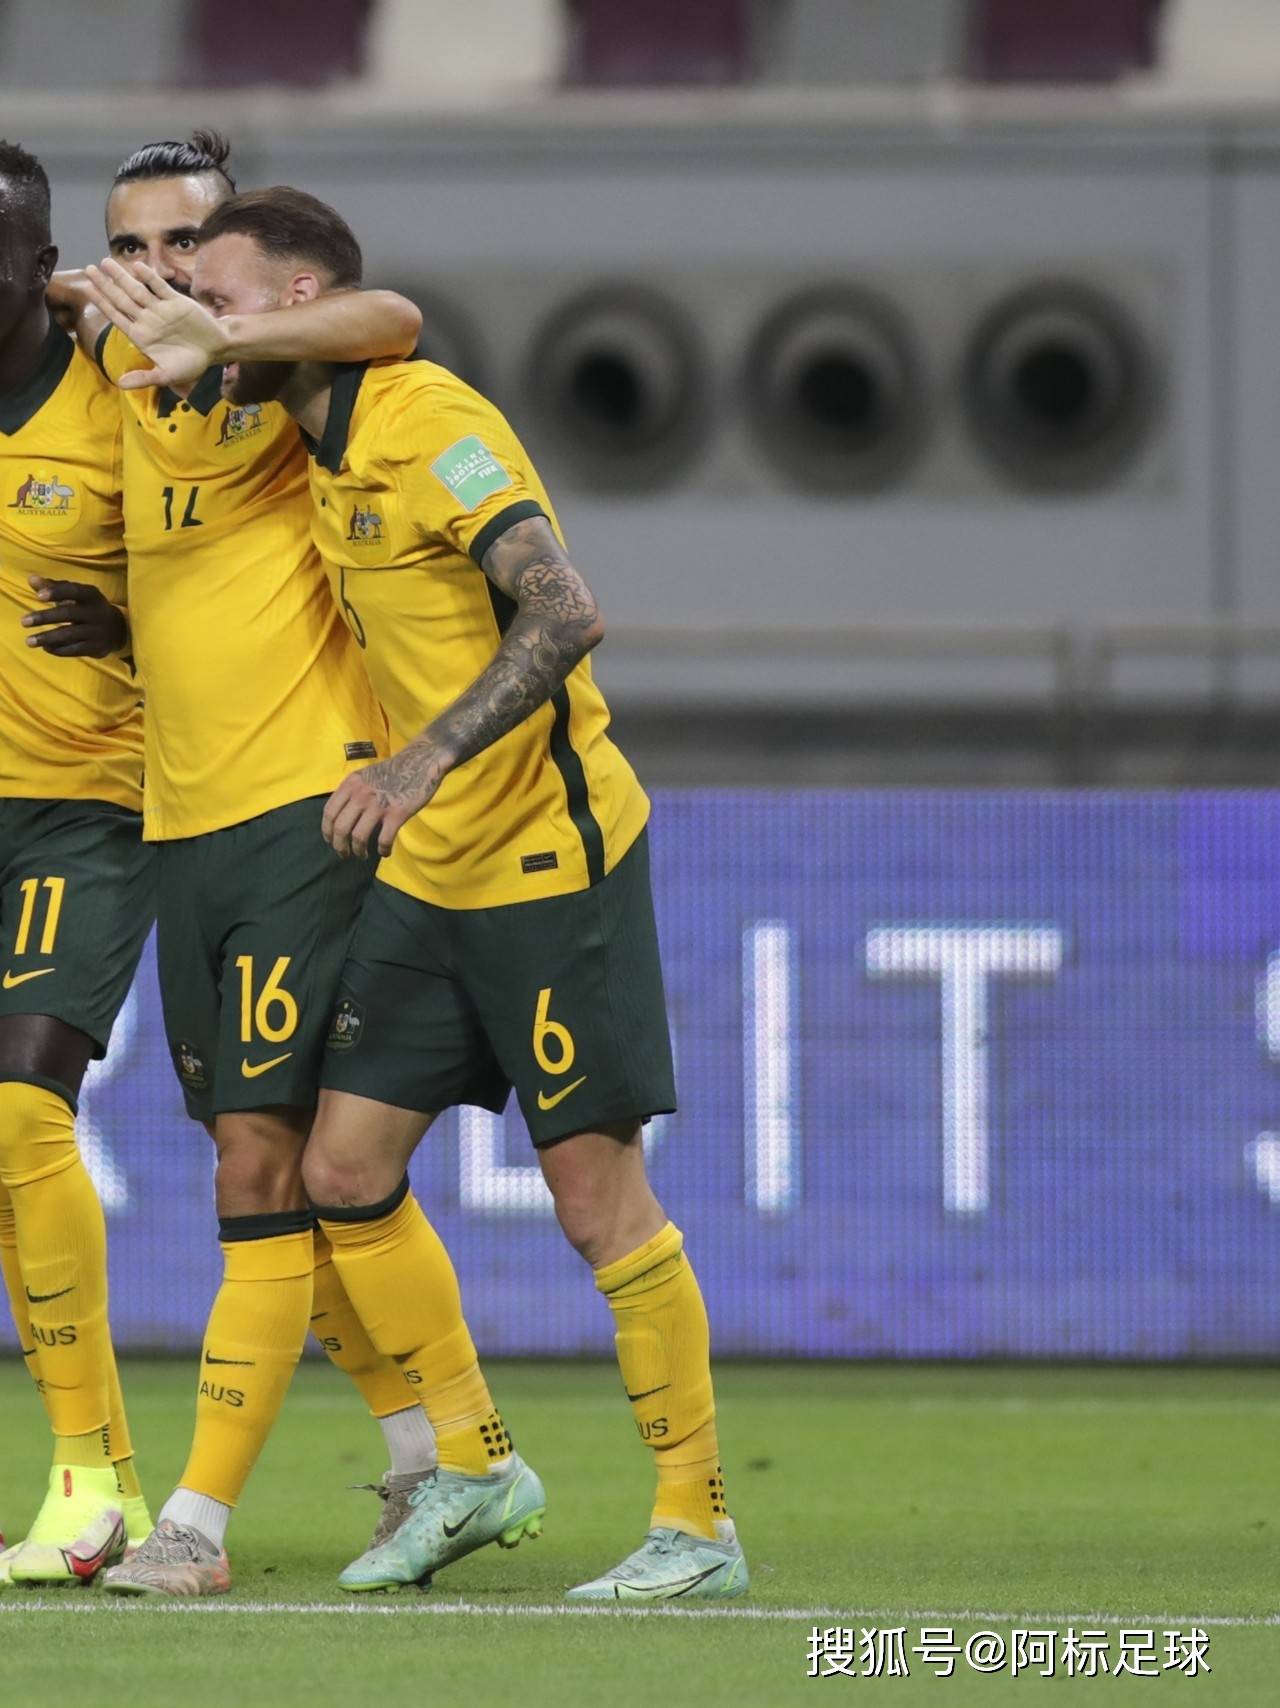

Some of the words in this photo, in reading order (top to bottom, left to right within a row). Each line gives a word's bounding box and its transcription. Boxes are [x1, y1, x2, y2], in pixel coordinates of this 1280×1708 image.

[14, 876, 65, 955] 11
[235, 955, 300, 1043] 16
[532, 987, 575, 1075] 6
[31, 1323, 77, 1346] AUS
[200, 1380, 245, 1407] AUS
